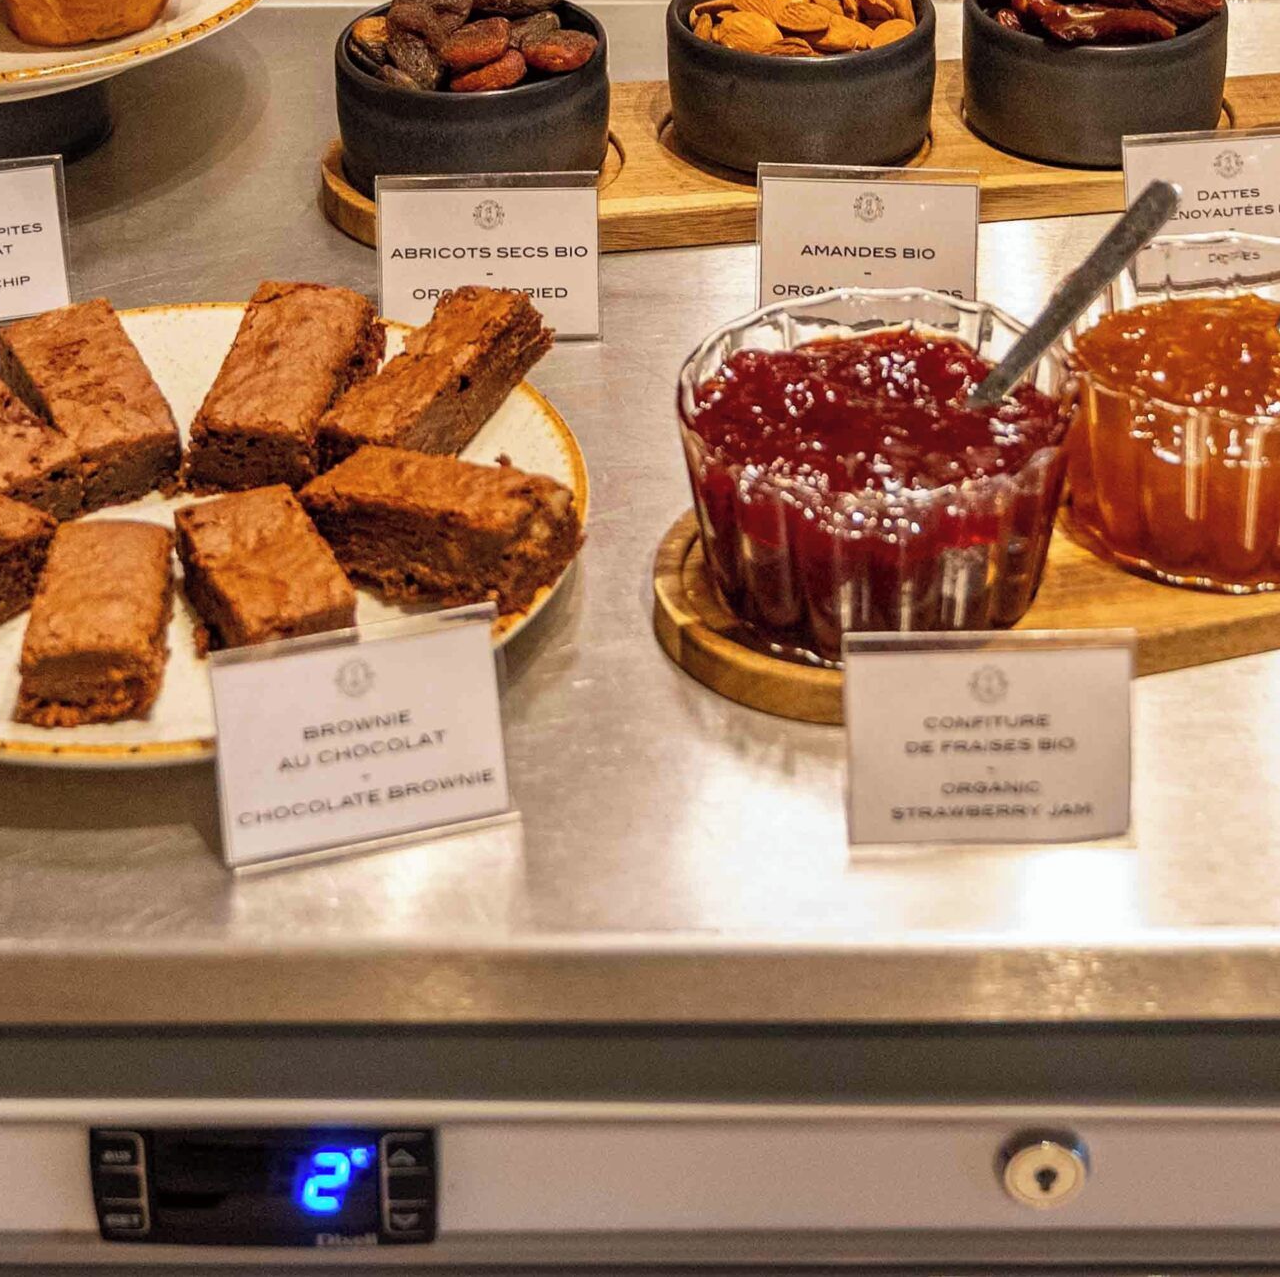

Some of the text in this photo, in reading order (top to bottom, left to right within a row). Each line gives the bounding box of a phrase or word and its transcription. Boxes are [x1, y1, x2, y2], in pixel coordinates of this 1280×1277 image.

[1197, 188, 1260, 201] DATTES
[391, 245, 588, 259] ABRICOTS SECS BIO
[801, 244, 936, 260] AMANDES BIO
[302, 709, 412, 742] BROWNIE
[923, 714, 1051, 730] CONFITURE
[278, 729, 447, 773] AU CHOCOLAT
[904, 736, 1076, 755] DE FRAISES BIO
[940, 780, 1042, 796] ORGANIC
[238, 767, 496, 828] CHOCOLATE BROWNIE
[891, 802, 1093, 820] STRAWBERRY JAM
